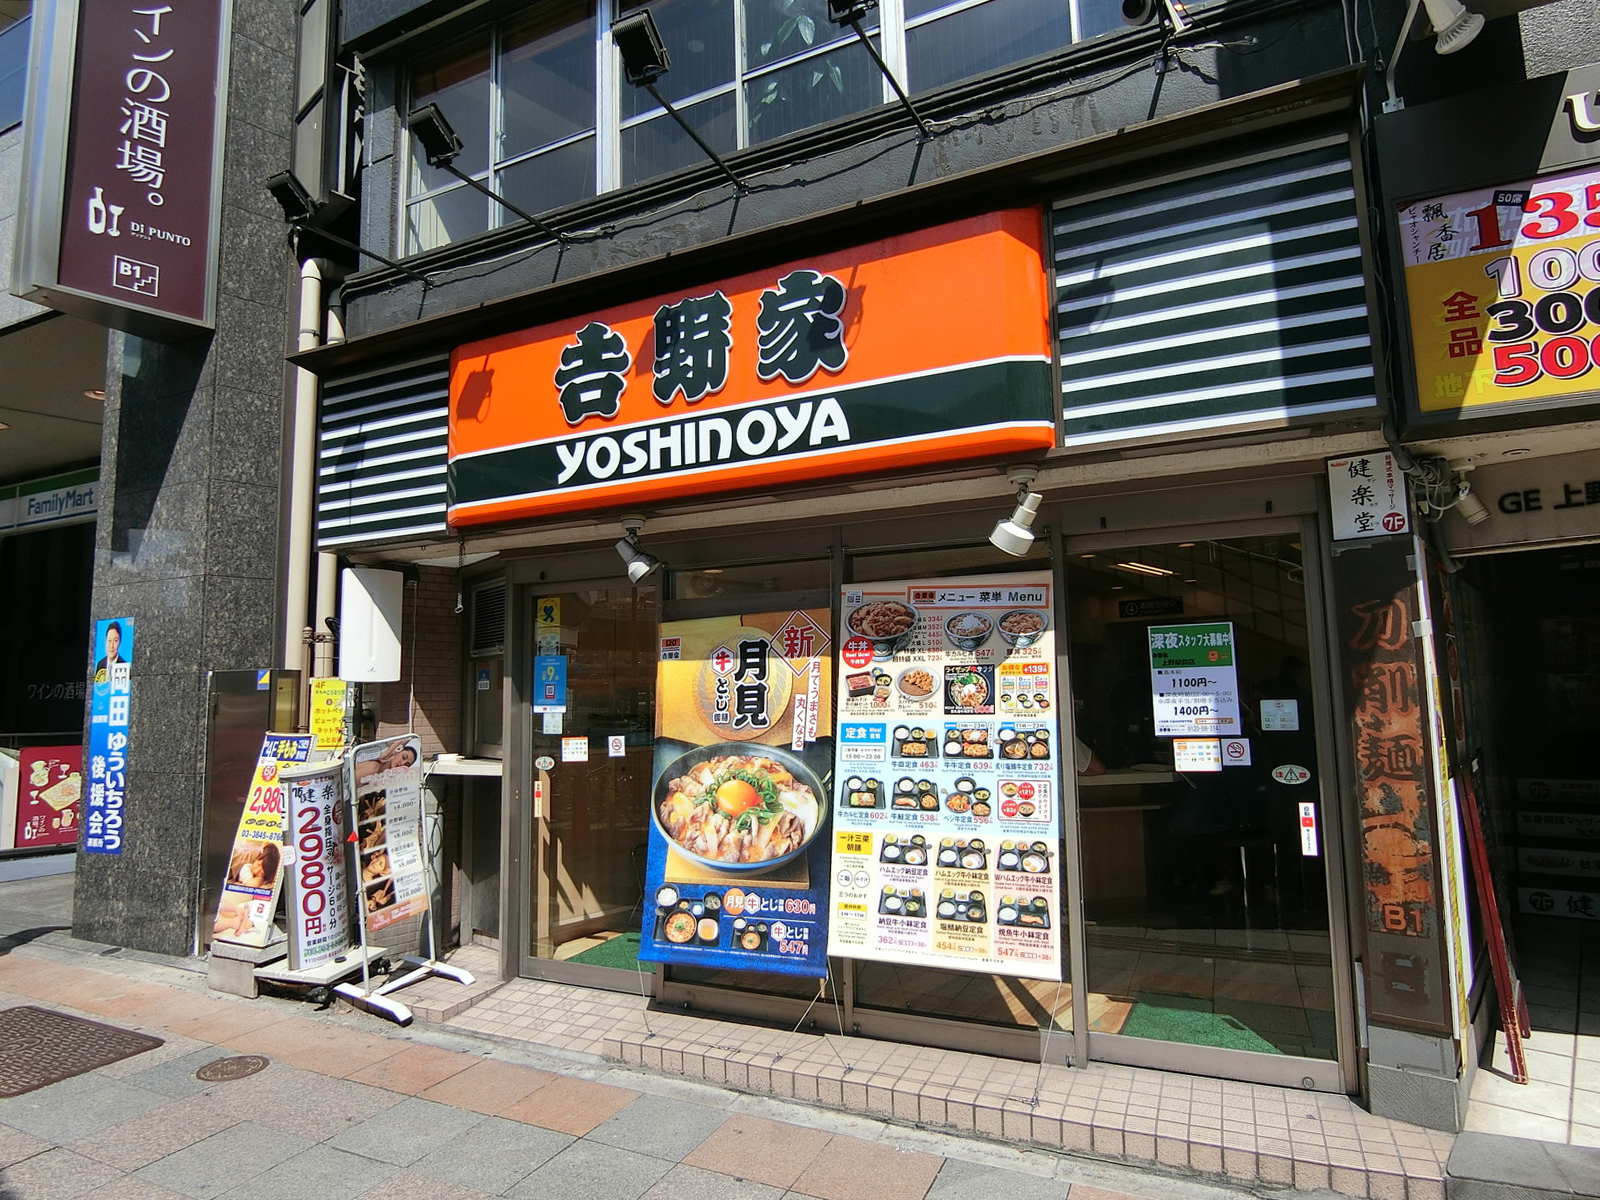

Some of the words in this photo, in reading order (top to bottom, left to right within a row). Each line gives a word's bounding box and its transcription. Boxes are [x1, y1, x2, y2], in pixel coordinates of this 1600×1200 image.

[149, 226, 191, 247] PUNTO
[119, 262, 141, 279] B1
[1442, 290, 1484, 358] 全品
[555, 396, 852, 485] YOSHINOYA
[27, 488, 95, 517] FamilyMart
[1347, 458, 1375, 533] 健楽堂
[1498, 489, 1542, 514] GE
[1384, 515, 1404, 530] 7F
[938, 592, 976, 602] メニュー
[1008, 591, 1042, 602] Menu
[784, 625, 814, 659] 新
[975, 649, 991, 657] 547
[1022, 647, 1038, 655] 325
[315, 681, 326, 689] 4F
[733, 638, 771, 728] 月見
[795, 697, 807, 748] 丸くなる
[845, 727, 867, 739] 定食
[89, 755, 107, 834] 後援会
[840, 834, 869, 842] 一汁三菜
[878, 917, 927, 929] 納豆牛小鉢定食
[1382, 904, 1422, 932] B1
[877, 935, 893, 944] 362
[936, 942, 952, 950] 454
[997, 947, 1014, 956] 547
